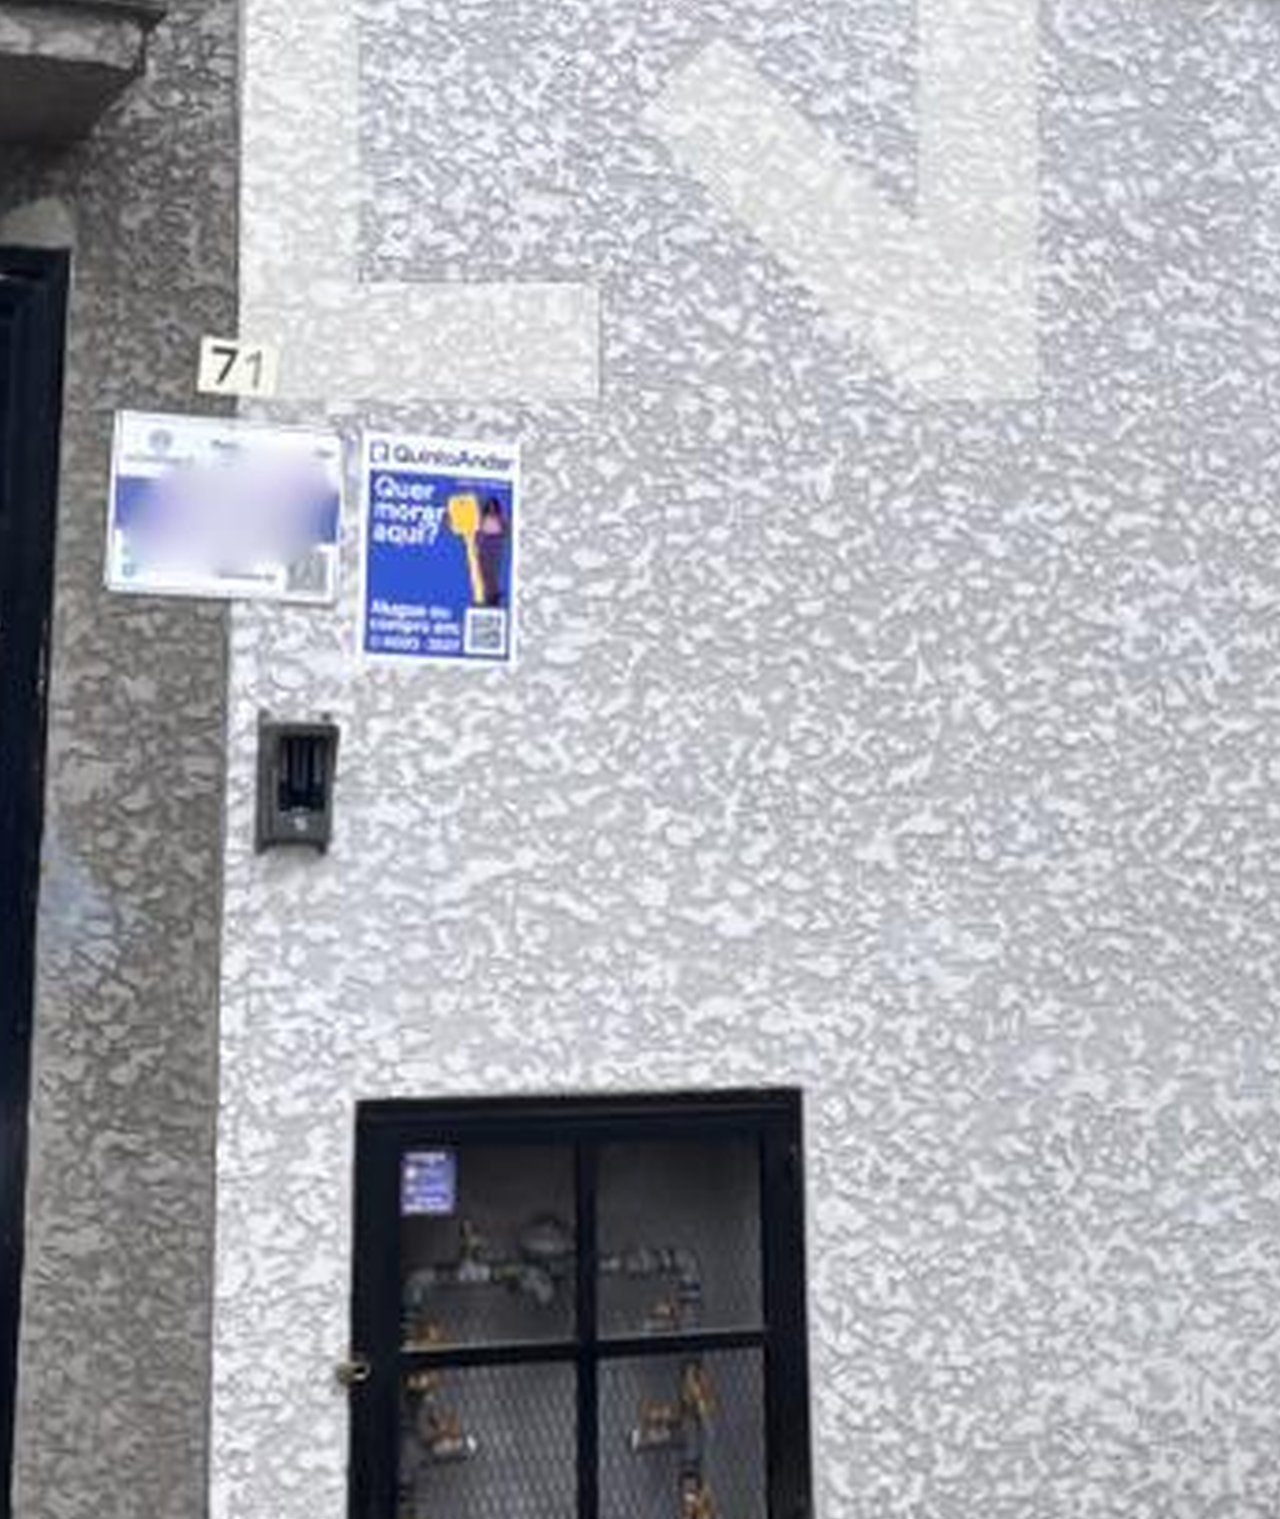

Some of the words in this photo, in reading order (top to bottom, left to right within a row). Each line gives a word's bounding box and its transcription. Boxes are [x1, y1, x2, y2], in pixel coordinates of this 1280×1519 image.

[211, 346, 262, 390] 71
[393, 444, 514, 471] QuintoAndar
[373, 475, 435, 499] Quer
[373, 503, 445, 523] morar
[373, 522, 439, 548] aqui?
